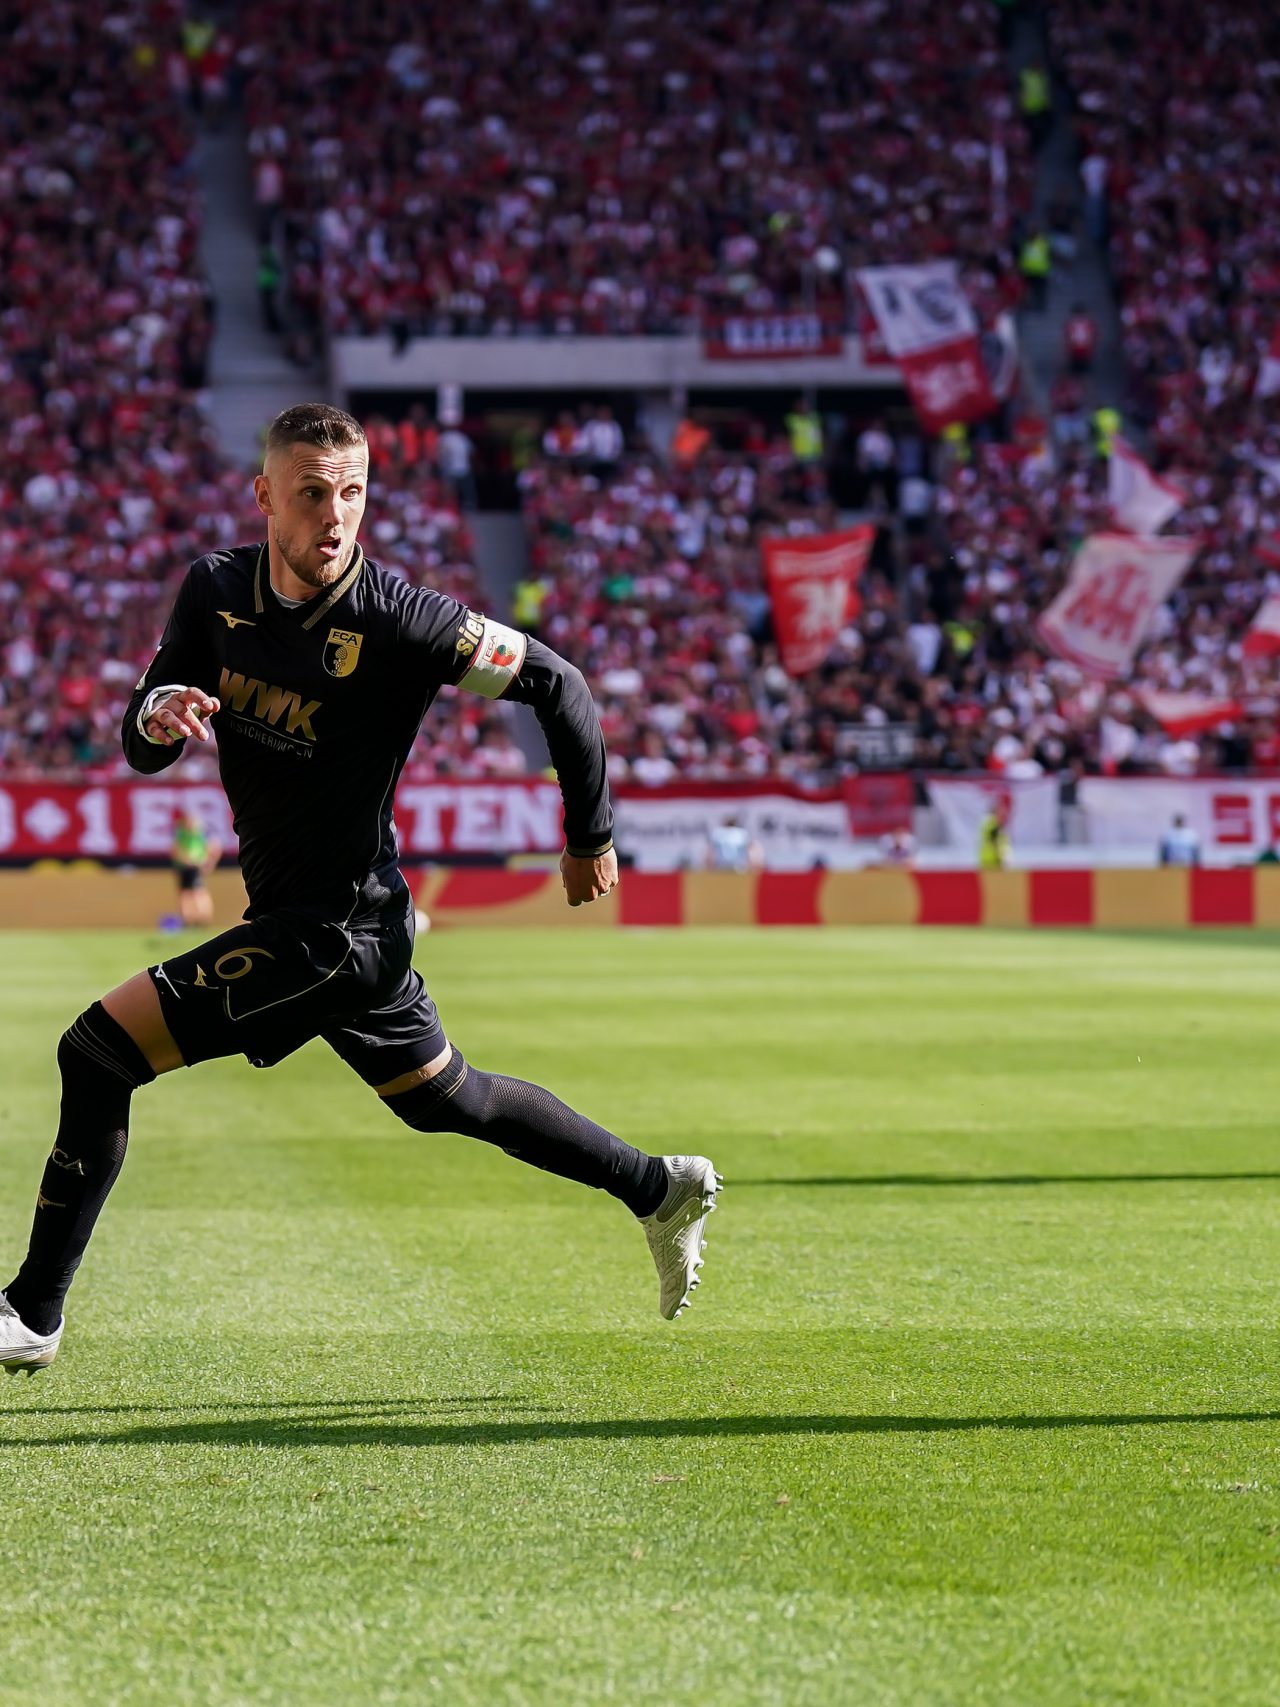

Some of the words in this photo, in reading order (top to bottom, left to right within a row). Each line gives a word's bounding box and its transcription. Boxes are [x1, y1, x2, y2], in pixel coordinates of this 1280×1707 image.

[331, 631, 358, 646] FCA
[219, 667, 322, 741] WWK
[214, 947, 276, 980] 6
